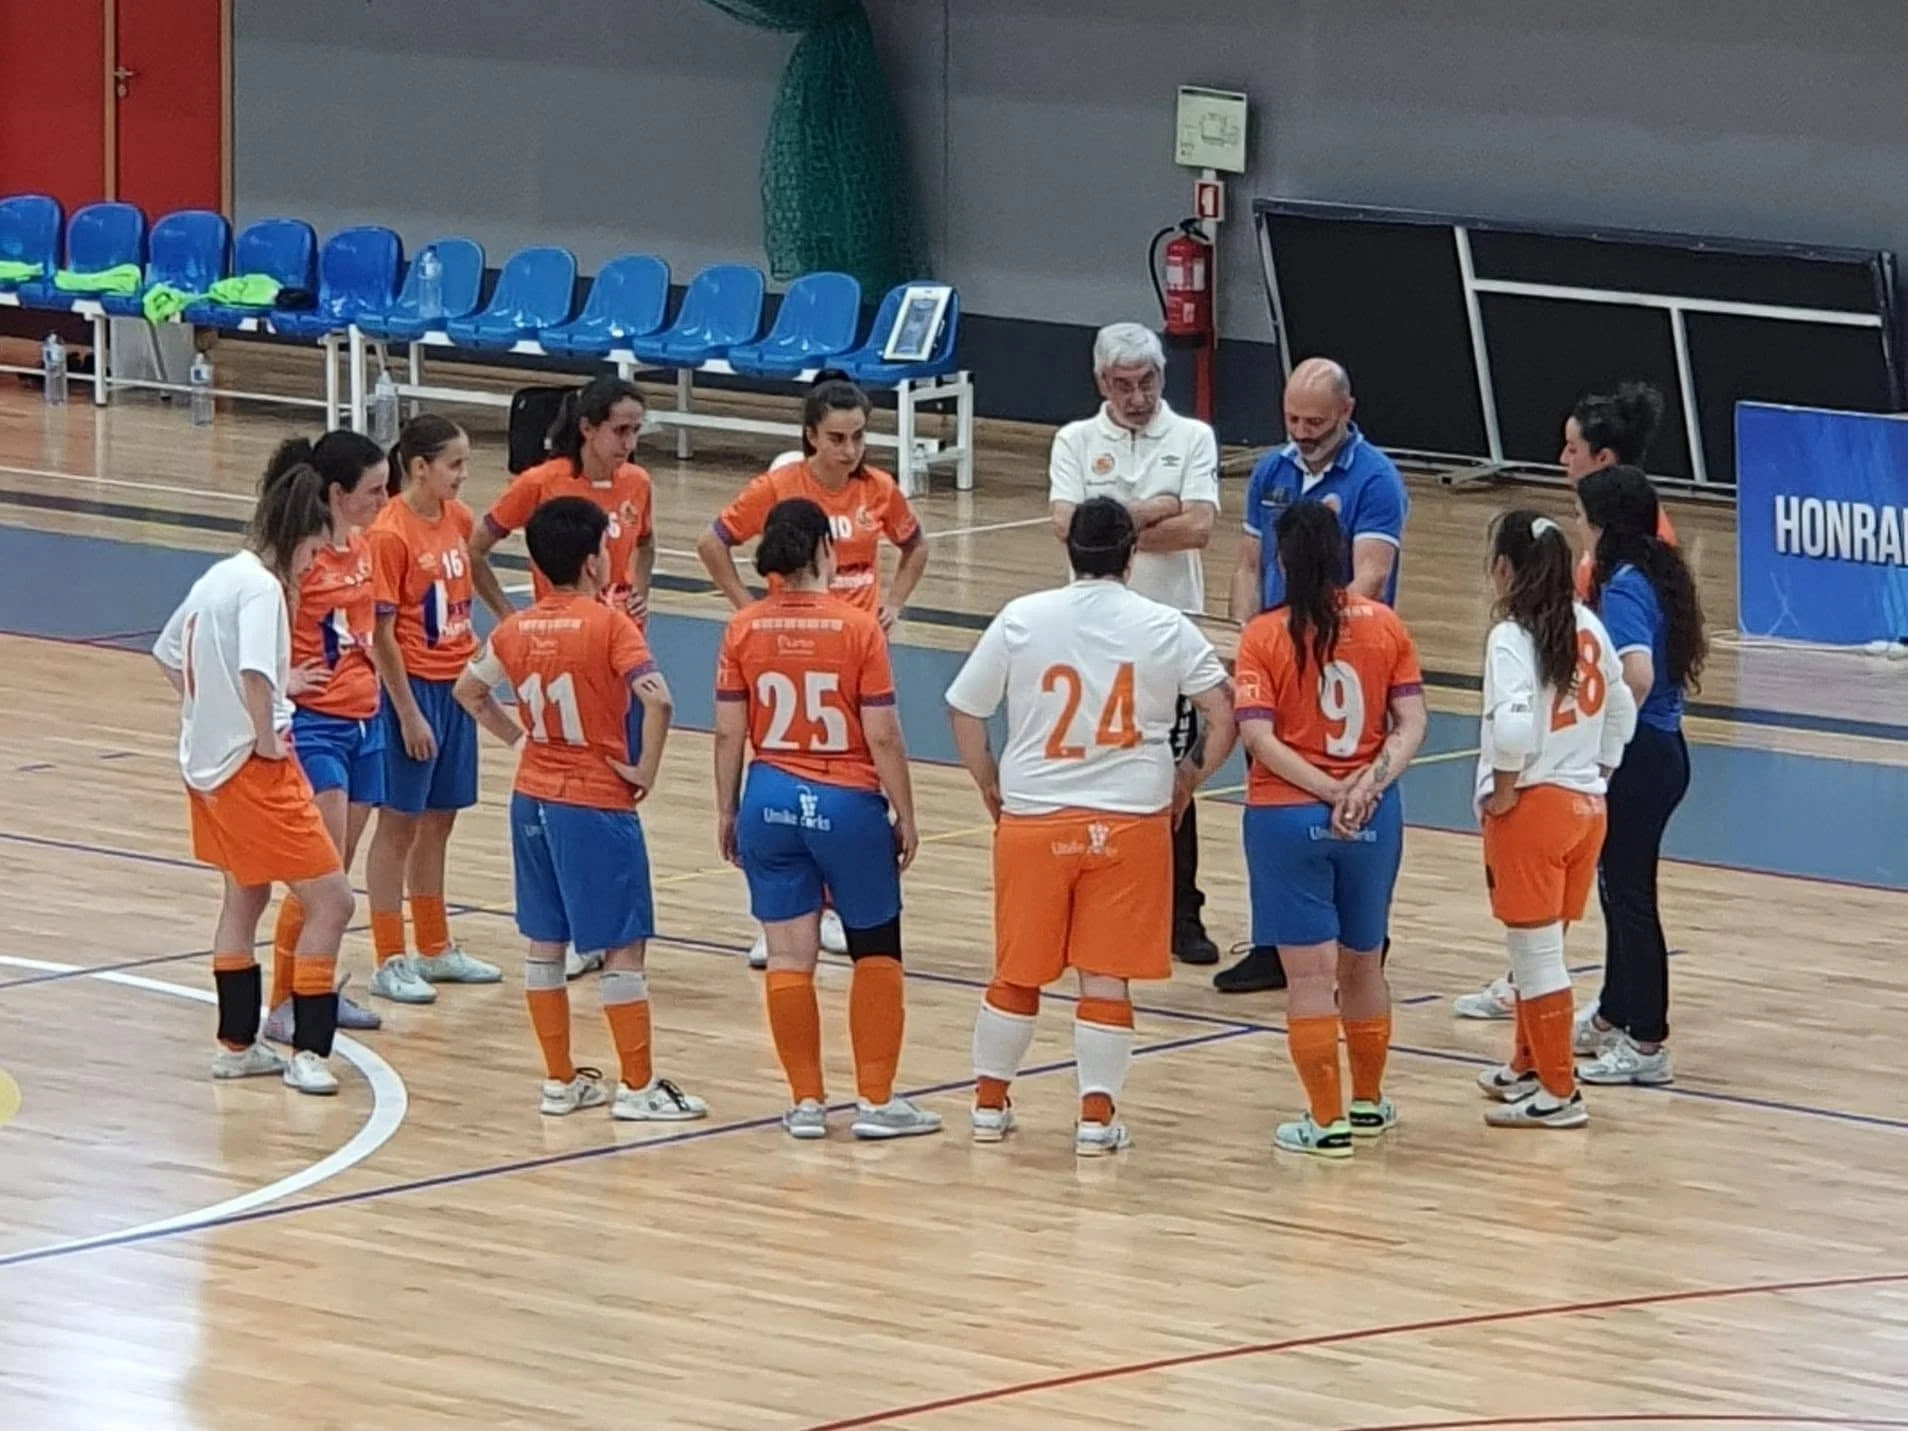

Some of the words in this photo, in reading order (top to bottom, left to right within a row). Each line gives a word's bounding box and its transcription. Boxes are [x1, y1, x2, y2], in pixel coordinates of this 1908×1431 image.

[442, 549, 464, 579] 16
[517, 672, 589, 746] 11
[757, 671, 849, 751] 25
[1041, 662, 1143, 760] 24
[1317, 660, 1365, 758] 9
